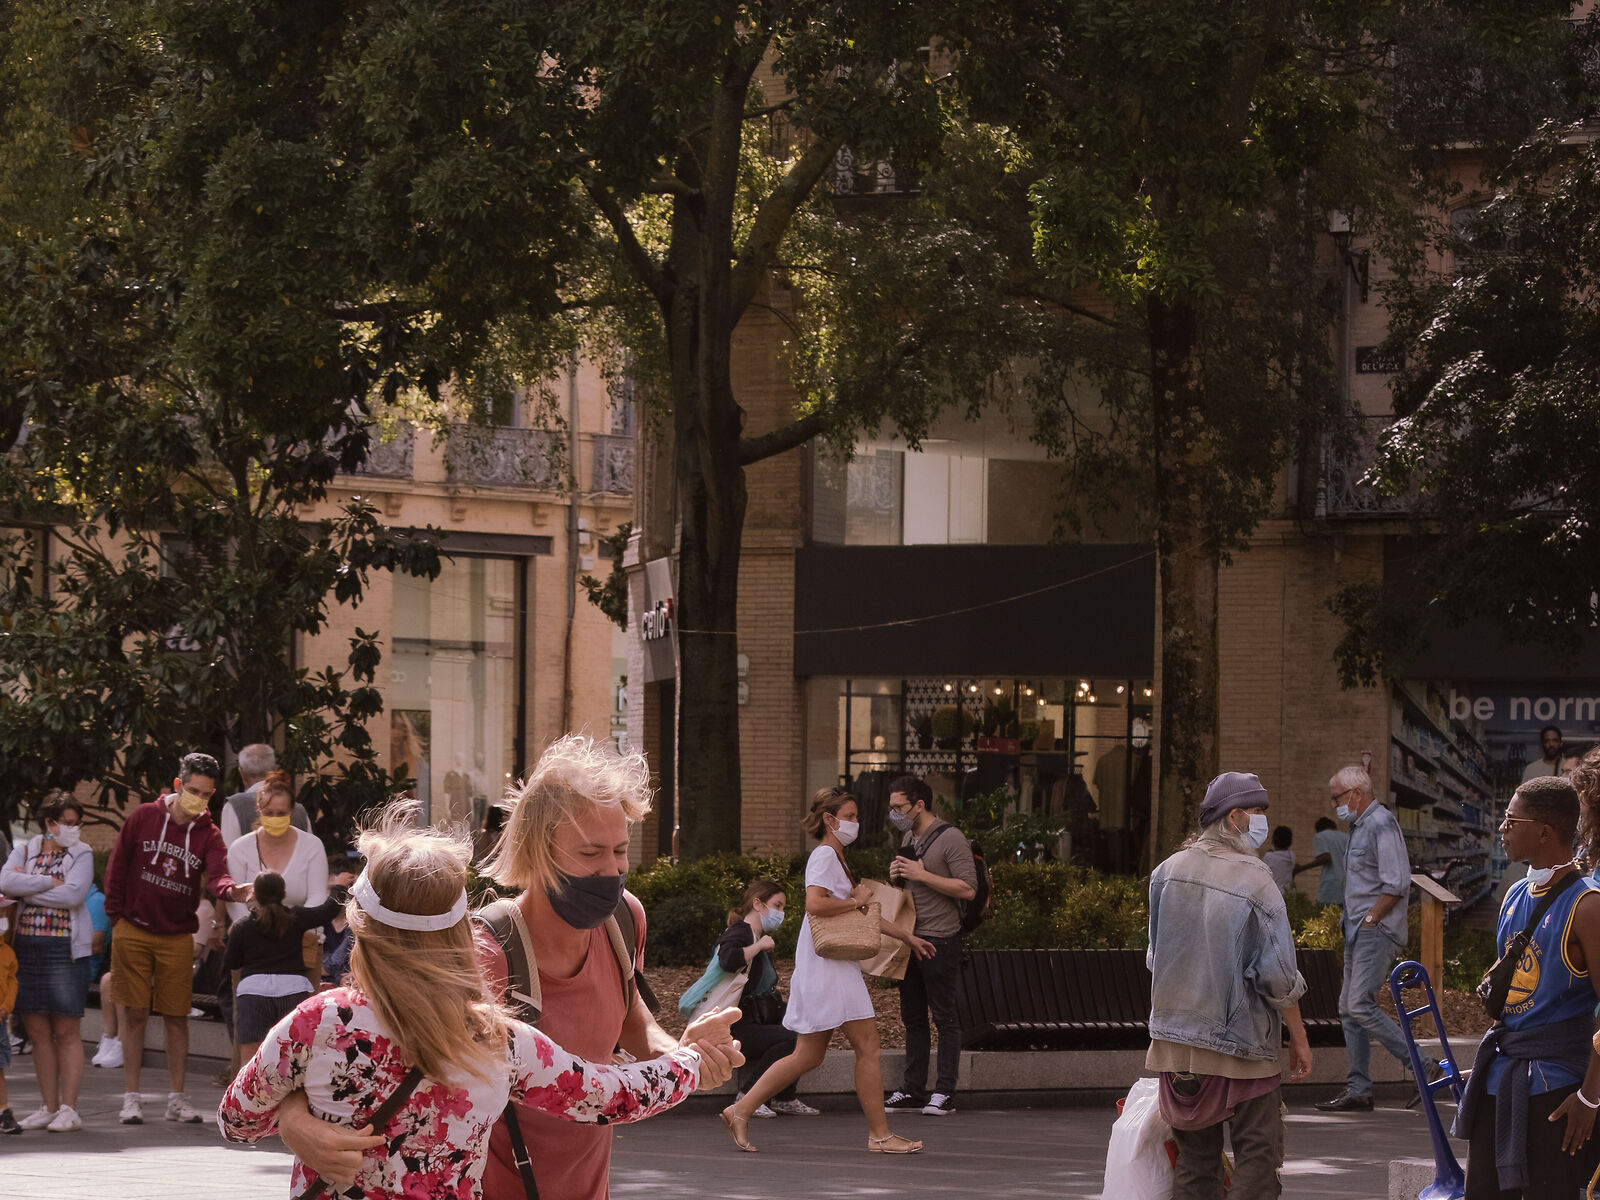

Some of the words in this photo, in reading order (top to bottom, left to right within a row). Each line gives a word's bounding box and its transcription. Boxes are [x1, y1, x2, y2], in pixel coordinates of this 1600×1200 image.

[1449, 688, 1495, 721] be
[1510, 696, 1600, 721] norm
[142, 840, 203, 870] CAMBRIDGE
[141, 871, 193, 896] UNIVERSITY
[1504, 999, 1535, 1015] RIORS
